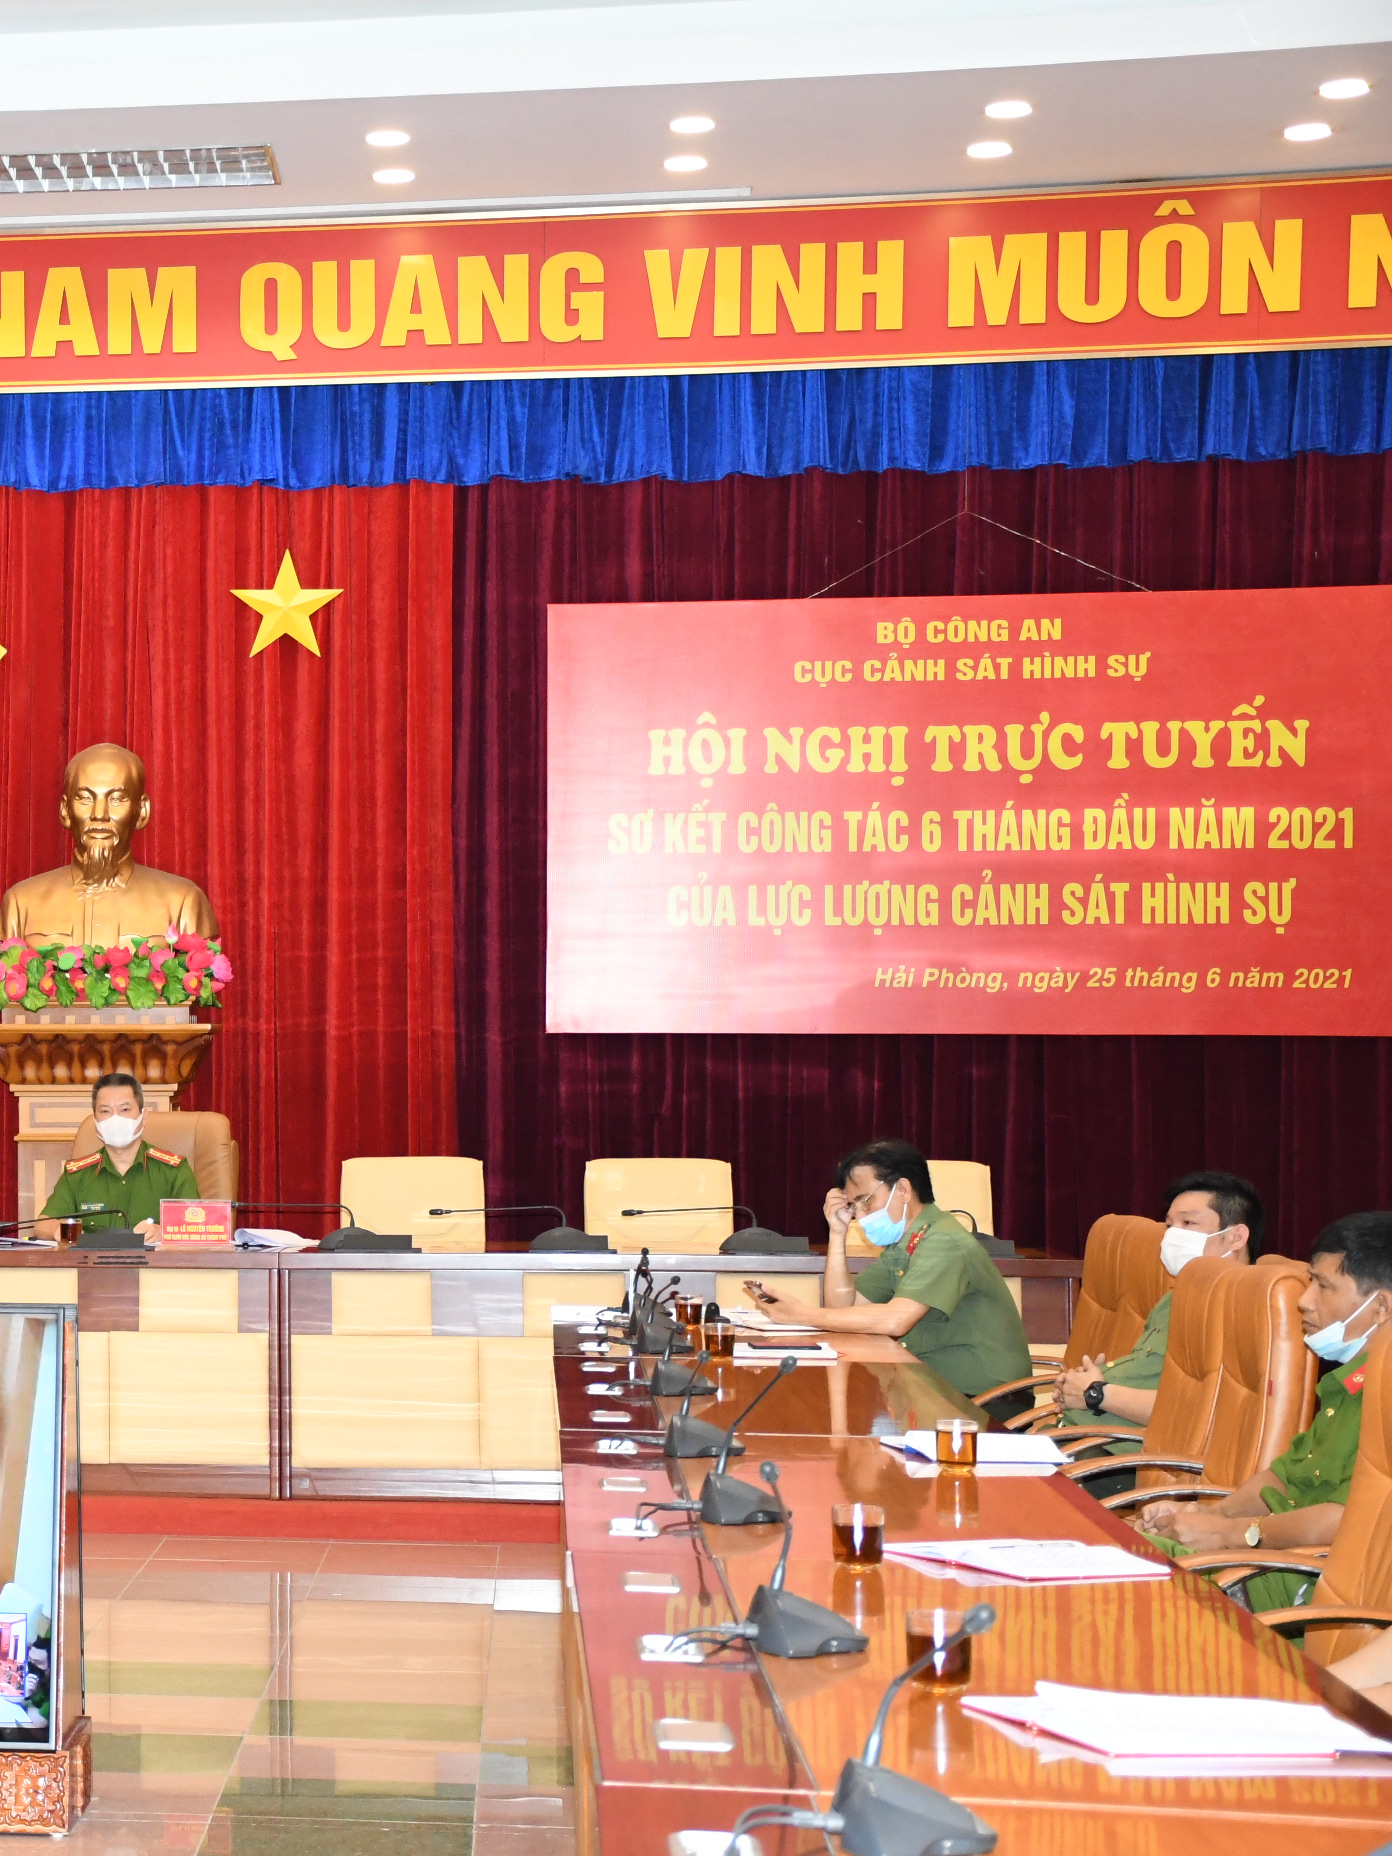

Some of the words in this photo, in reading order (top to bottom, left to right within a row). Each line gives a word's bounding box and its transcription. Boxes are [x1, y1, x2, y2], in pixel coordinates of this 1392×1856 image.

[239, 251, 605, 362] QUANG
[643, 239, 905, 339] VINH
[947, 199, 1303, 328] MUÔN
[876, 617, 916, 649] BỘ
[927, 615, 1009, 644] CÔNG
[1019, 617, 1062, 642] AN
[794, 660, 853, 687] CỤC
[863, 652, 945, 682] CẢNH
[955, 653, 1013, 681] SÁT
[1022, 652, 1096, 680] HÌNH
[1106, 651, 1151, 682] SỰ
[648, 711, 747, 787] HỘI
[763, 725, 909, 787] NGHỊ
[924, 711, 1085, 785] TRỰC
[1099, 694, 1310, 770] TUYẾN
[608, 808, 654, 854] SƠ
[664, 799, 726, 853] KẾT
[738, 803, 832, 853] CÔNG
[844, 802, 909, 852] TÁC
[921, 811, 942, 852] 6
[953, 800, 1072, 852] THÁNG
[1082, 793, 1156, 851] ĐẦU
[1169, 798, 1255, 850] NĂM
[1268, 806, 1354, 850] 2021
[667, 871, 736, 927] CỦA
[749, 880, 812, 935] LỰC
[825, 880, 939, 935] LƯỢNG
[951, 869, 1049, 926] CẢNH
[1061, 873, 1130, 925] SÁT
[1141, 873, 1230, 925] HÌNH
[1243, 877, 1298, 935] SỰ
[875, 966, 914, 988] Hải
[922, 967, 1009, 993] Phòng,
[1018, 967, 1080, 993] ngày
[1087, 967, 1117, 988] 25
[1124, 966, 1199, 993] tháng
[1206, 967, 1221, 988] 6
[1229, 967, 1284, 989] năm
[1292, 967, 1353, 989] 2021
